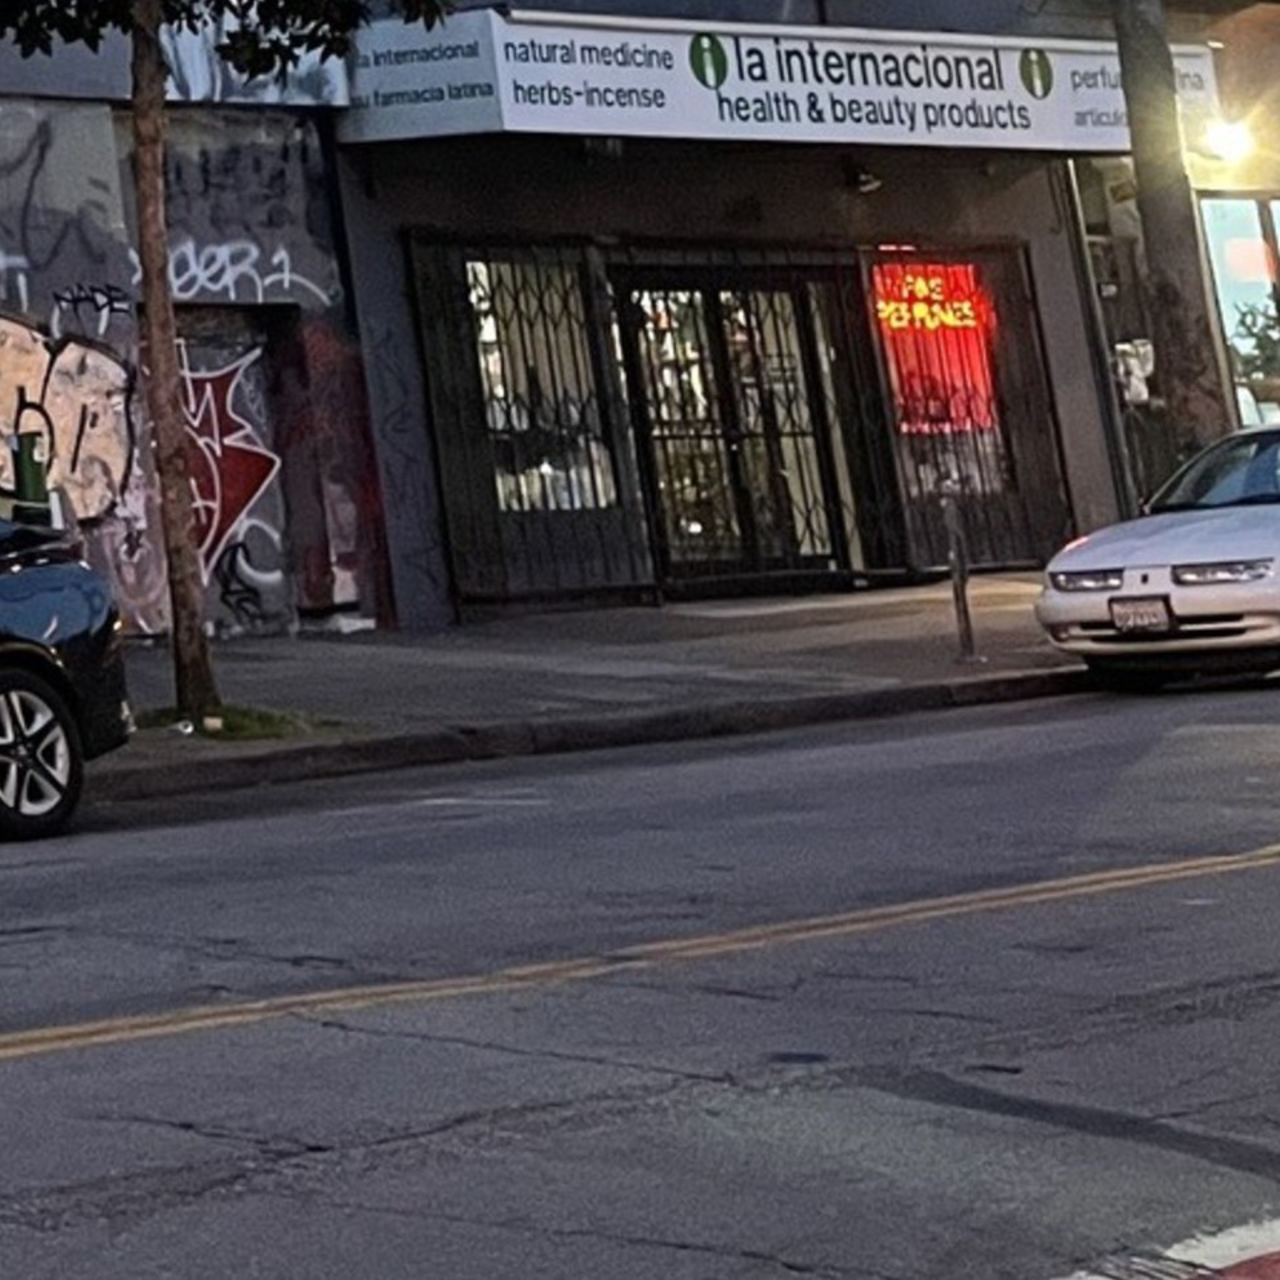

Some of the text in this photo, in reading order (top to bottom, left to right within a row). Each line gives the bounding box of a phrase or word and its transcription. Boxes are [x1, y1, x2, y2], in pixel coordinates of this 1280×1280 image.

[373, 40, 480, 66] internacional
[503, 39, 675, 71] natural medicine
[735, 38, 1005, 92] la internacional
[373, 87, 445, 106] farmacia
[448, 82, 494, 100] latina
[513, 79, 667, 109] herbs-incense
[1070, 66, 1123, 92] perfu
[717, 88, 1032, 133] health & beauty products
